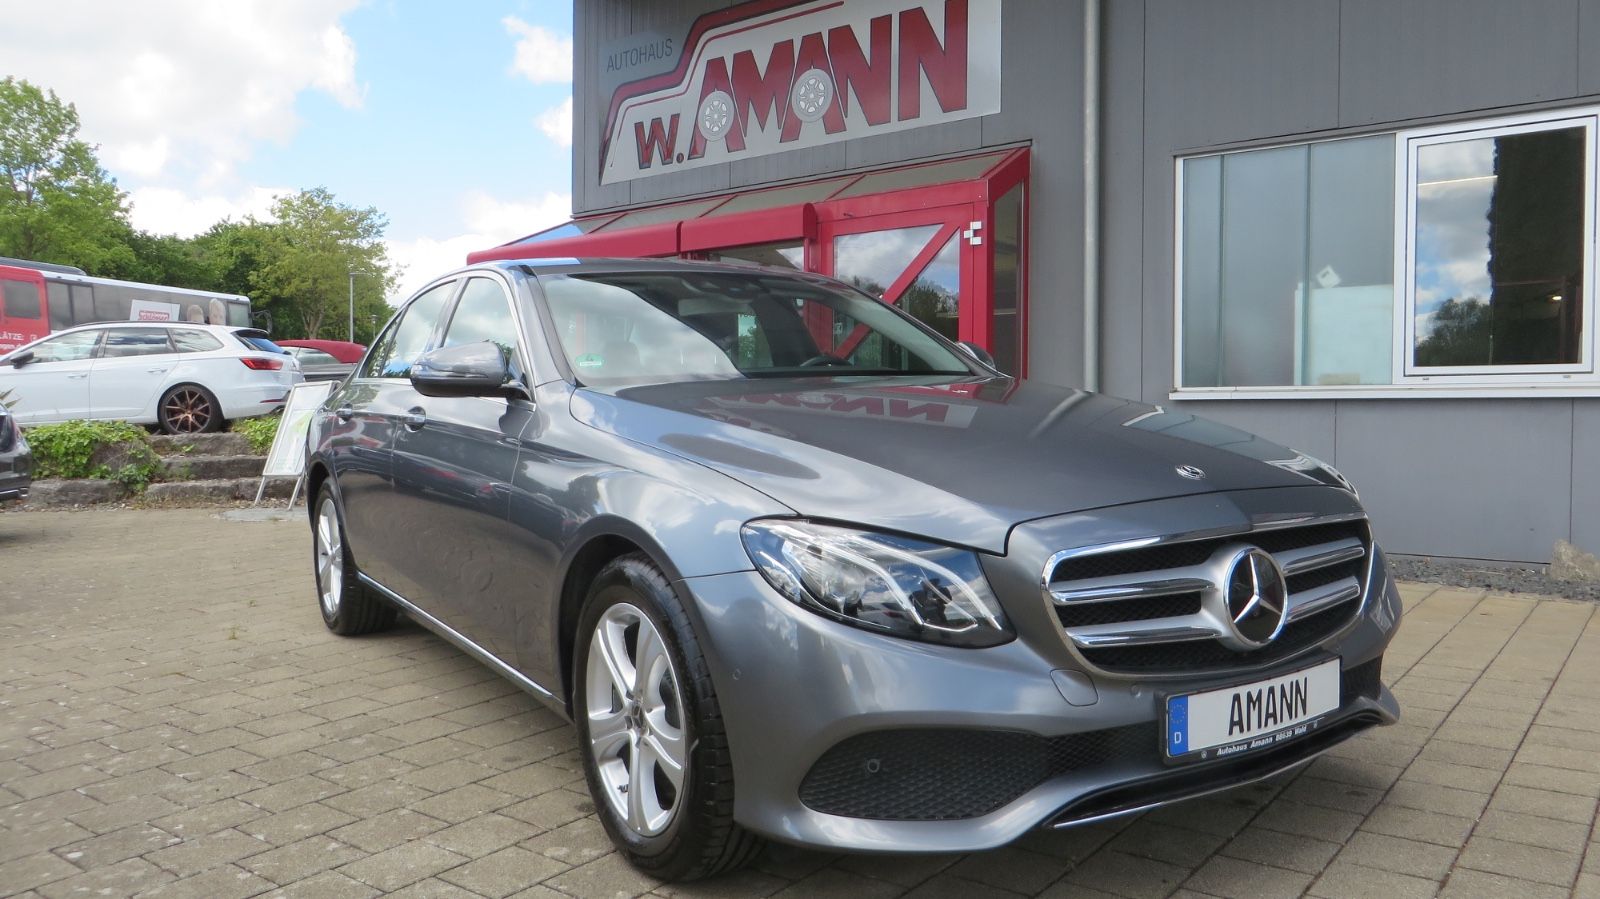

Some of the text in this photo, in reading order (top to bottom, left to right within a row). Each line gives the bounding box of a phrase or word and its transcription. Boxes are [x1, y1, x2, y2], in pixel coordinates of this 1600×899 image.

[606, 38, 673, 72] AUTOHAUS
[1228, 676, 1308, 736] AMANN
[1174, 731, 1182, 745] D
[1217, 743, 1247, 755] Autohaus
[1250, 736, 1273, 748] Amann
